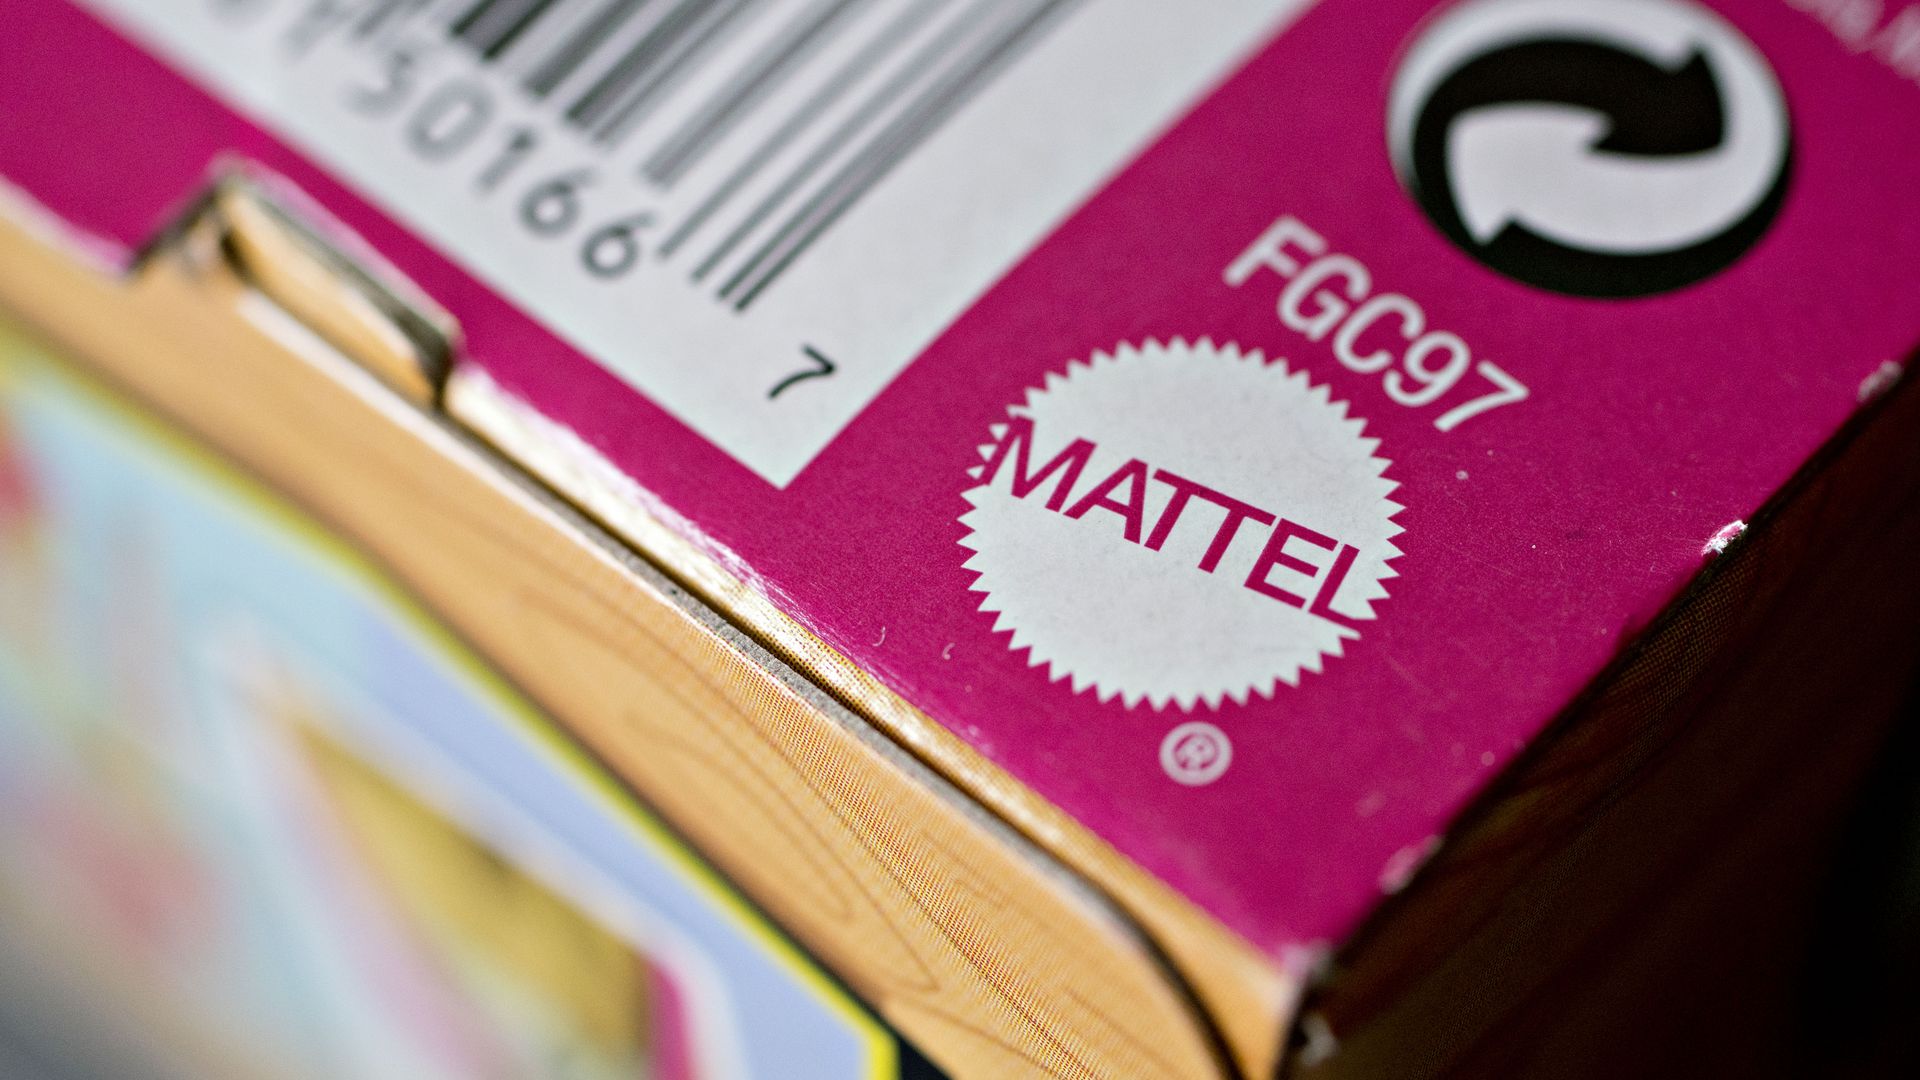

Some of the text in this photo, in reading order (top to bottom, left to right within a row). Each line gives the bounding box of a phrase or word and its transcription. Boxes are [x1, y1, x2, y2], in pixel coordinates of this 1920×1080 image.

[766, 344, 837, 400] 7
[1223, 214, 1530, 433] FGC97
[974, 412, 1362, 626] MATTEL
